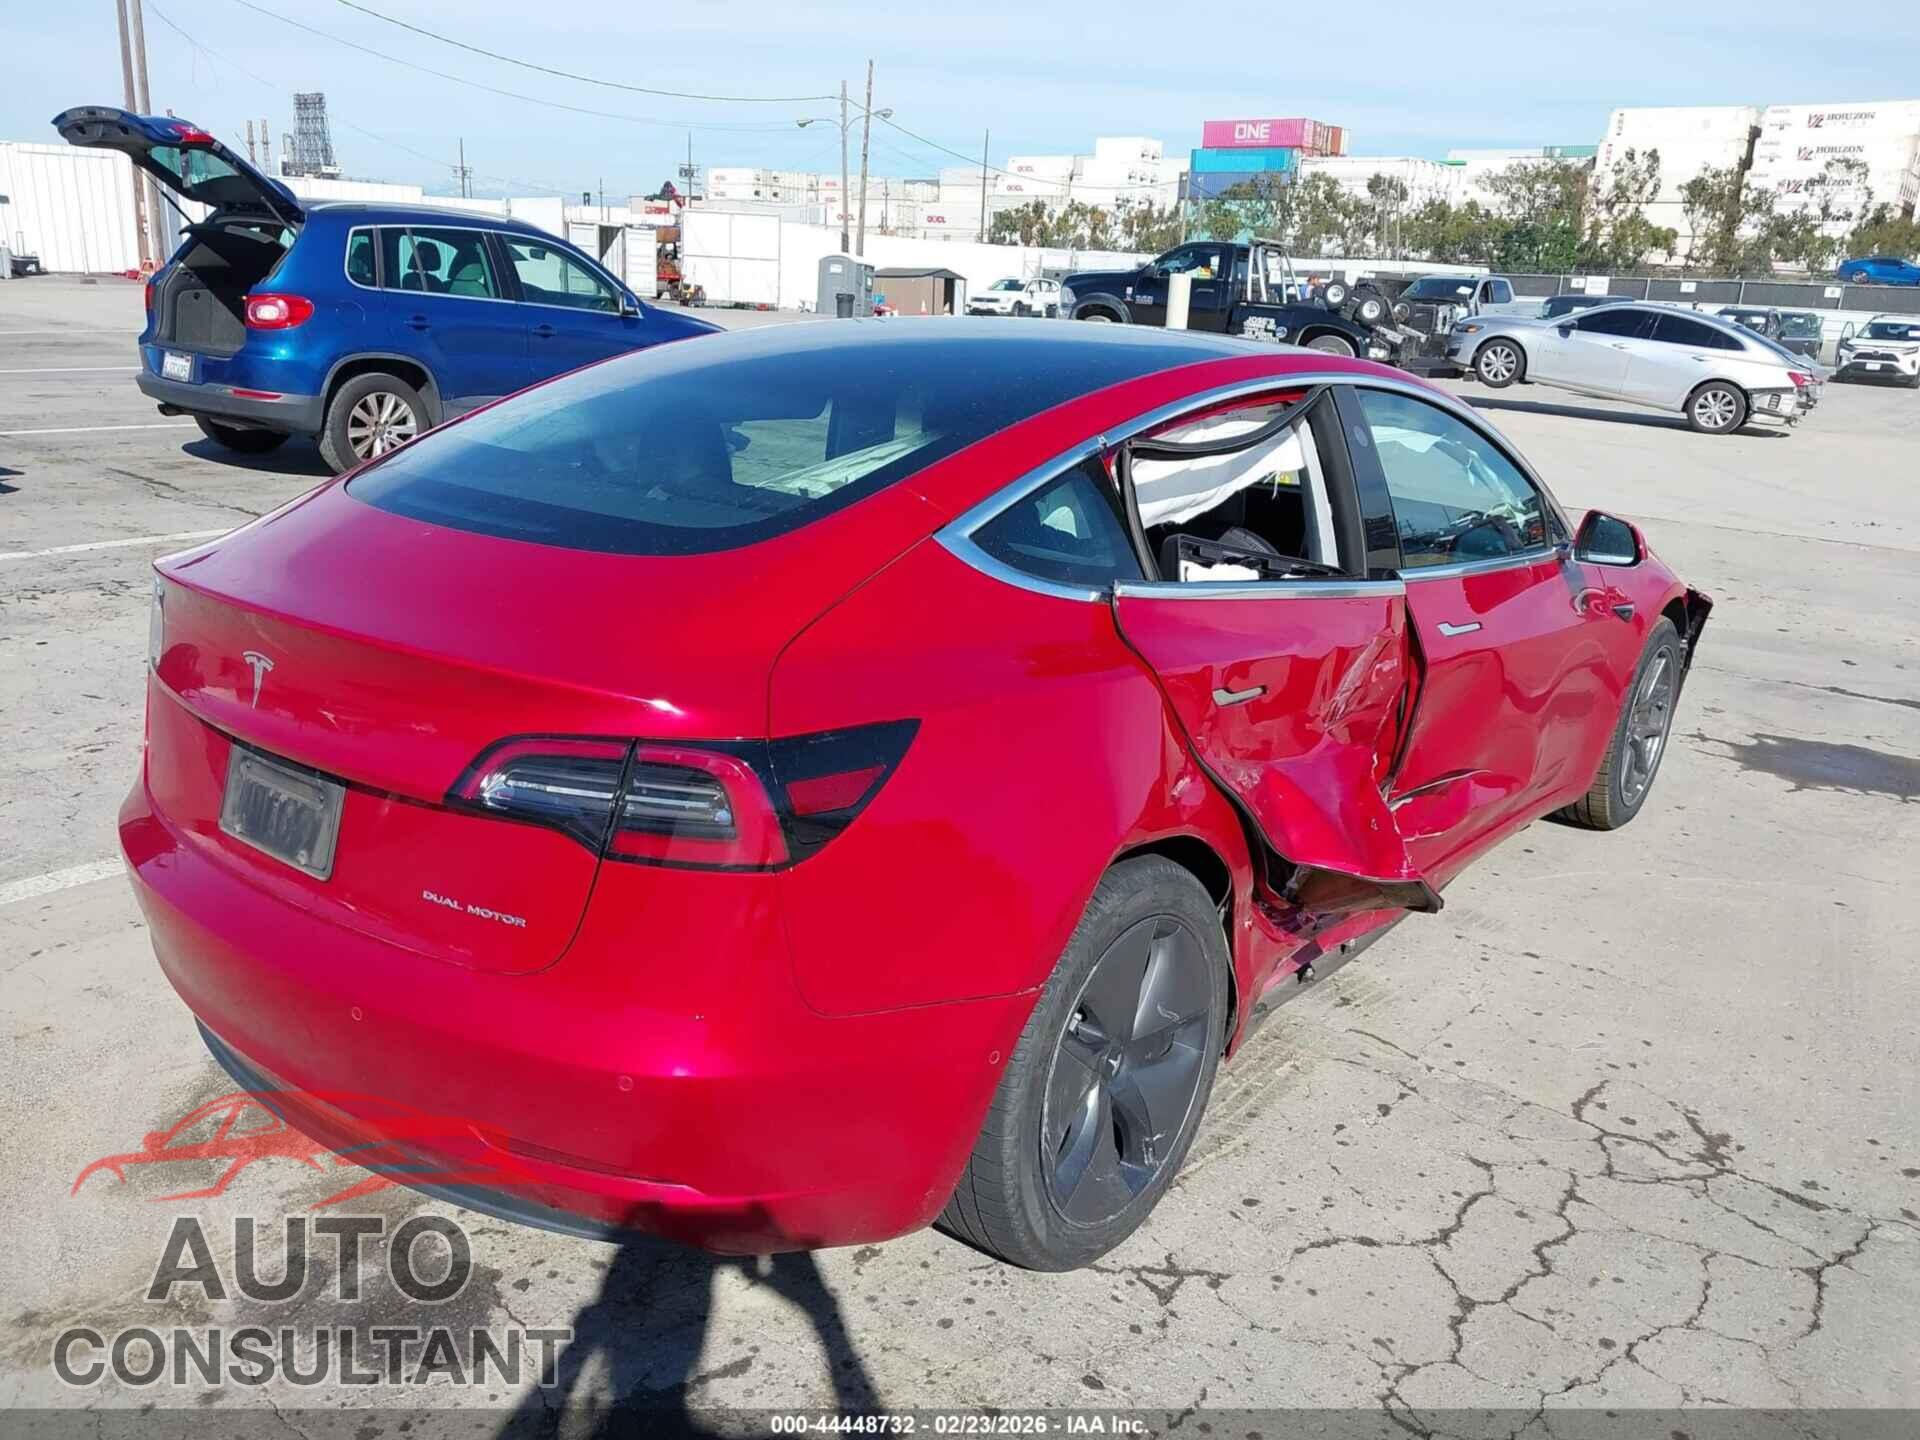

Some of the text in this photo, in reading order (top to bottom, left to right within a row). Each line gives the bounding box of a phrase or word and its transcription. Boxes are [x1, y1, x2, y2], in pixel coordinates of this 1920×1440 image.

[1826, 112, 1876, 121] HORIZON
[1234, 123, 1271, 139] ONE
[1815, 145, 1864, 154] HORIZON
[422, 890, 527, 928] DUAL MOTOR
